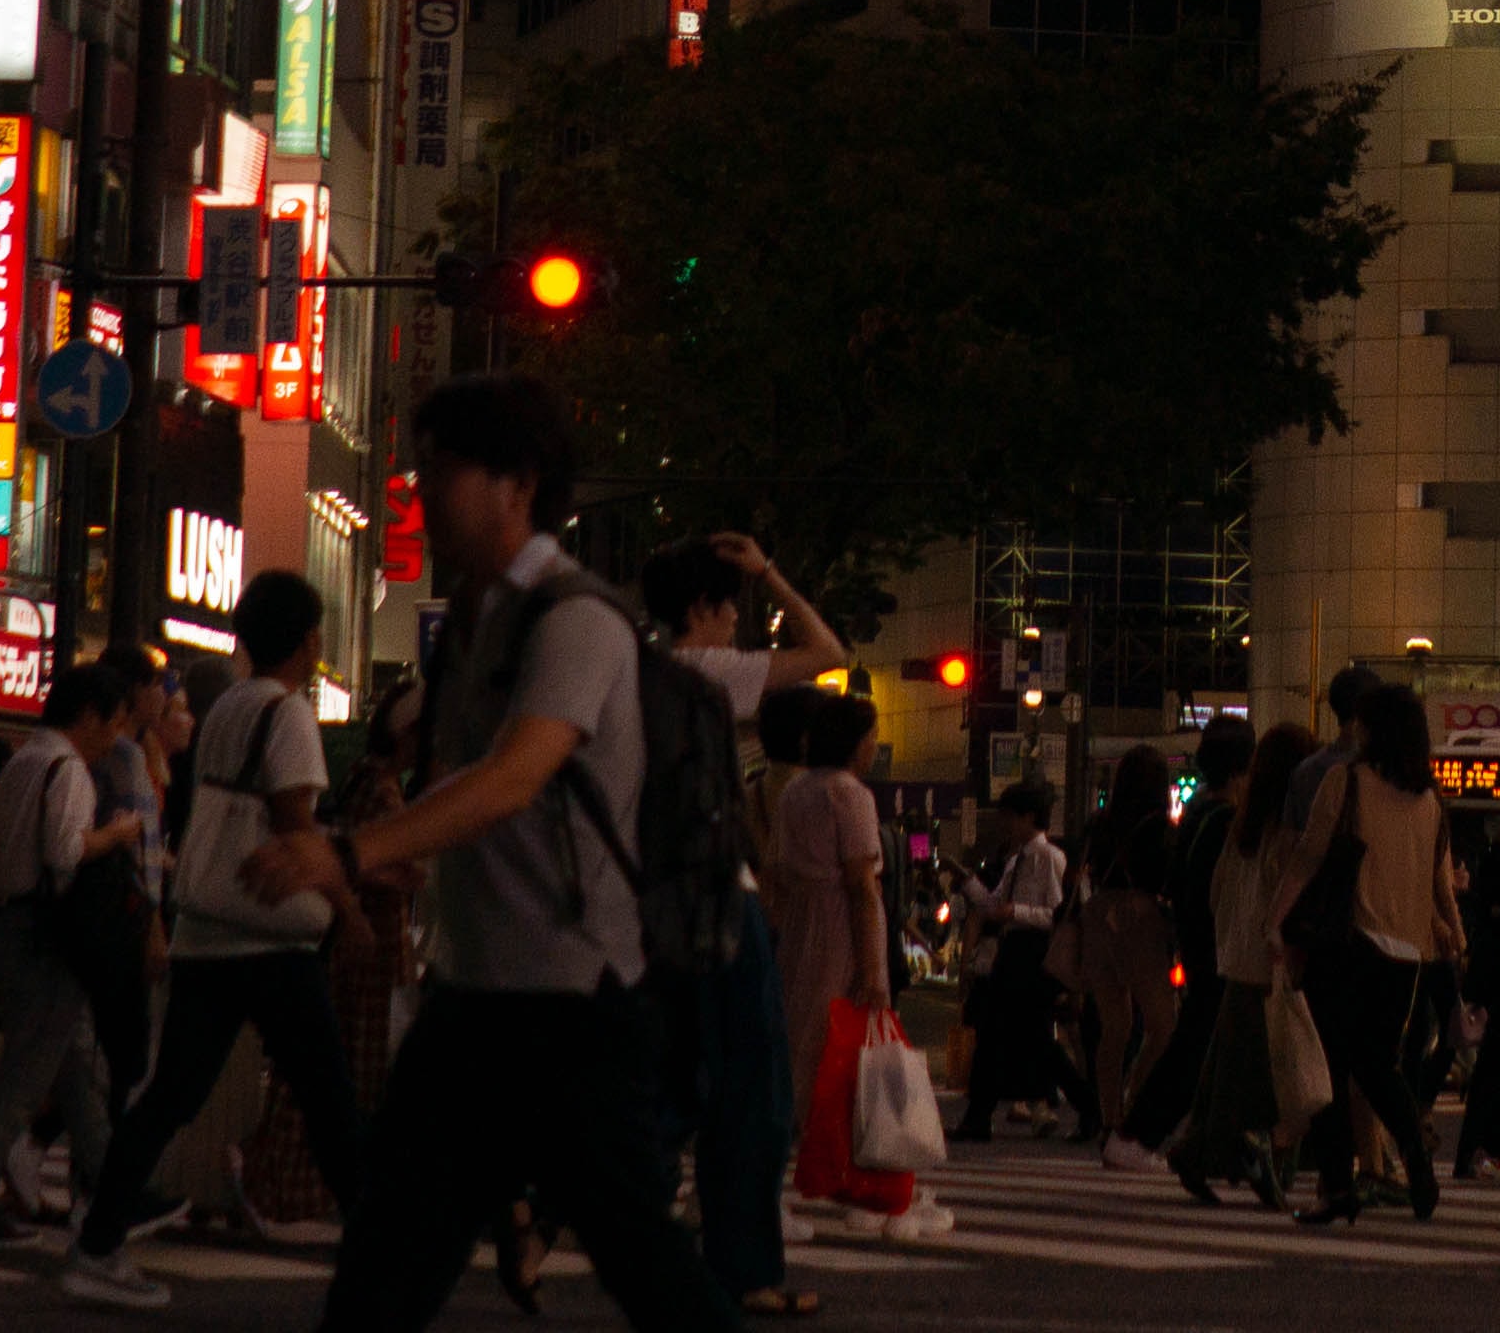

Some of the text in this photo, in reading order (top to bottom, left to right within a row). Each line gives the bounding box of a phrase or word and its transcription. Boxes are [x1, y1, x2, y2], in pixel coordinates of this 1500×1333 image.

[282, 15, 314, 125] ALSA
[275, 381, 300, 399] 3F
[168, 508, 244, 614] LUSH
